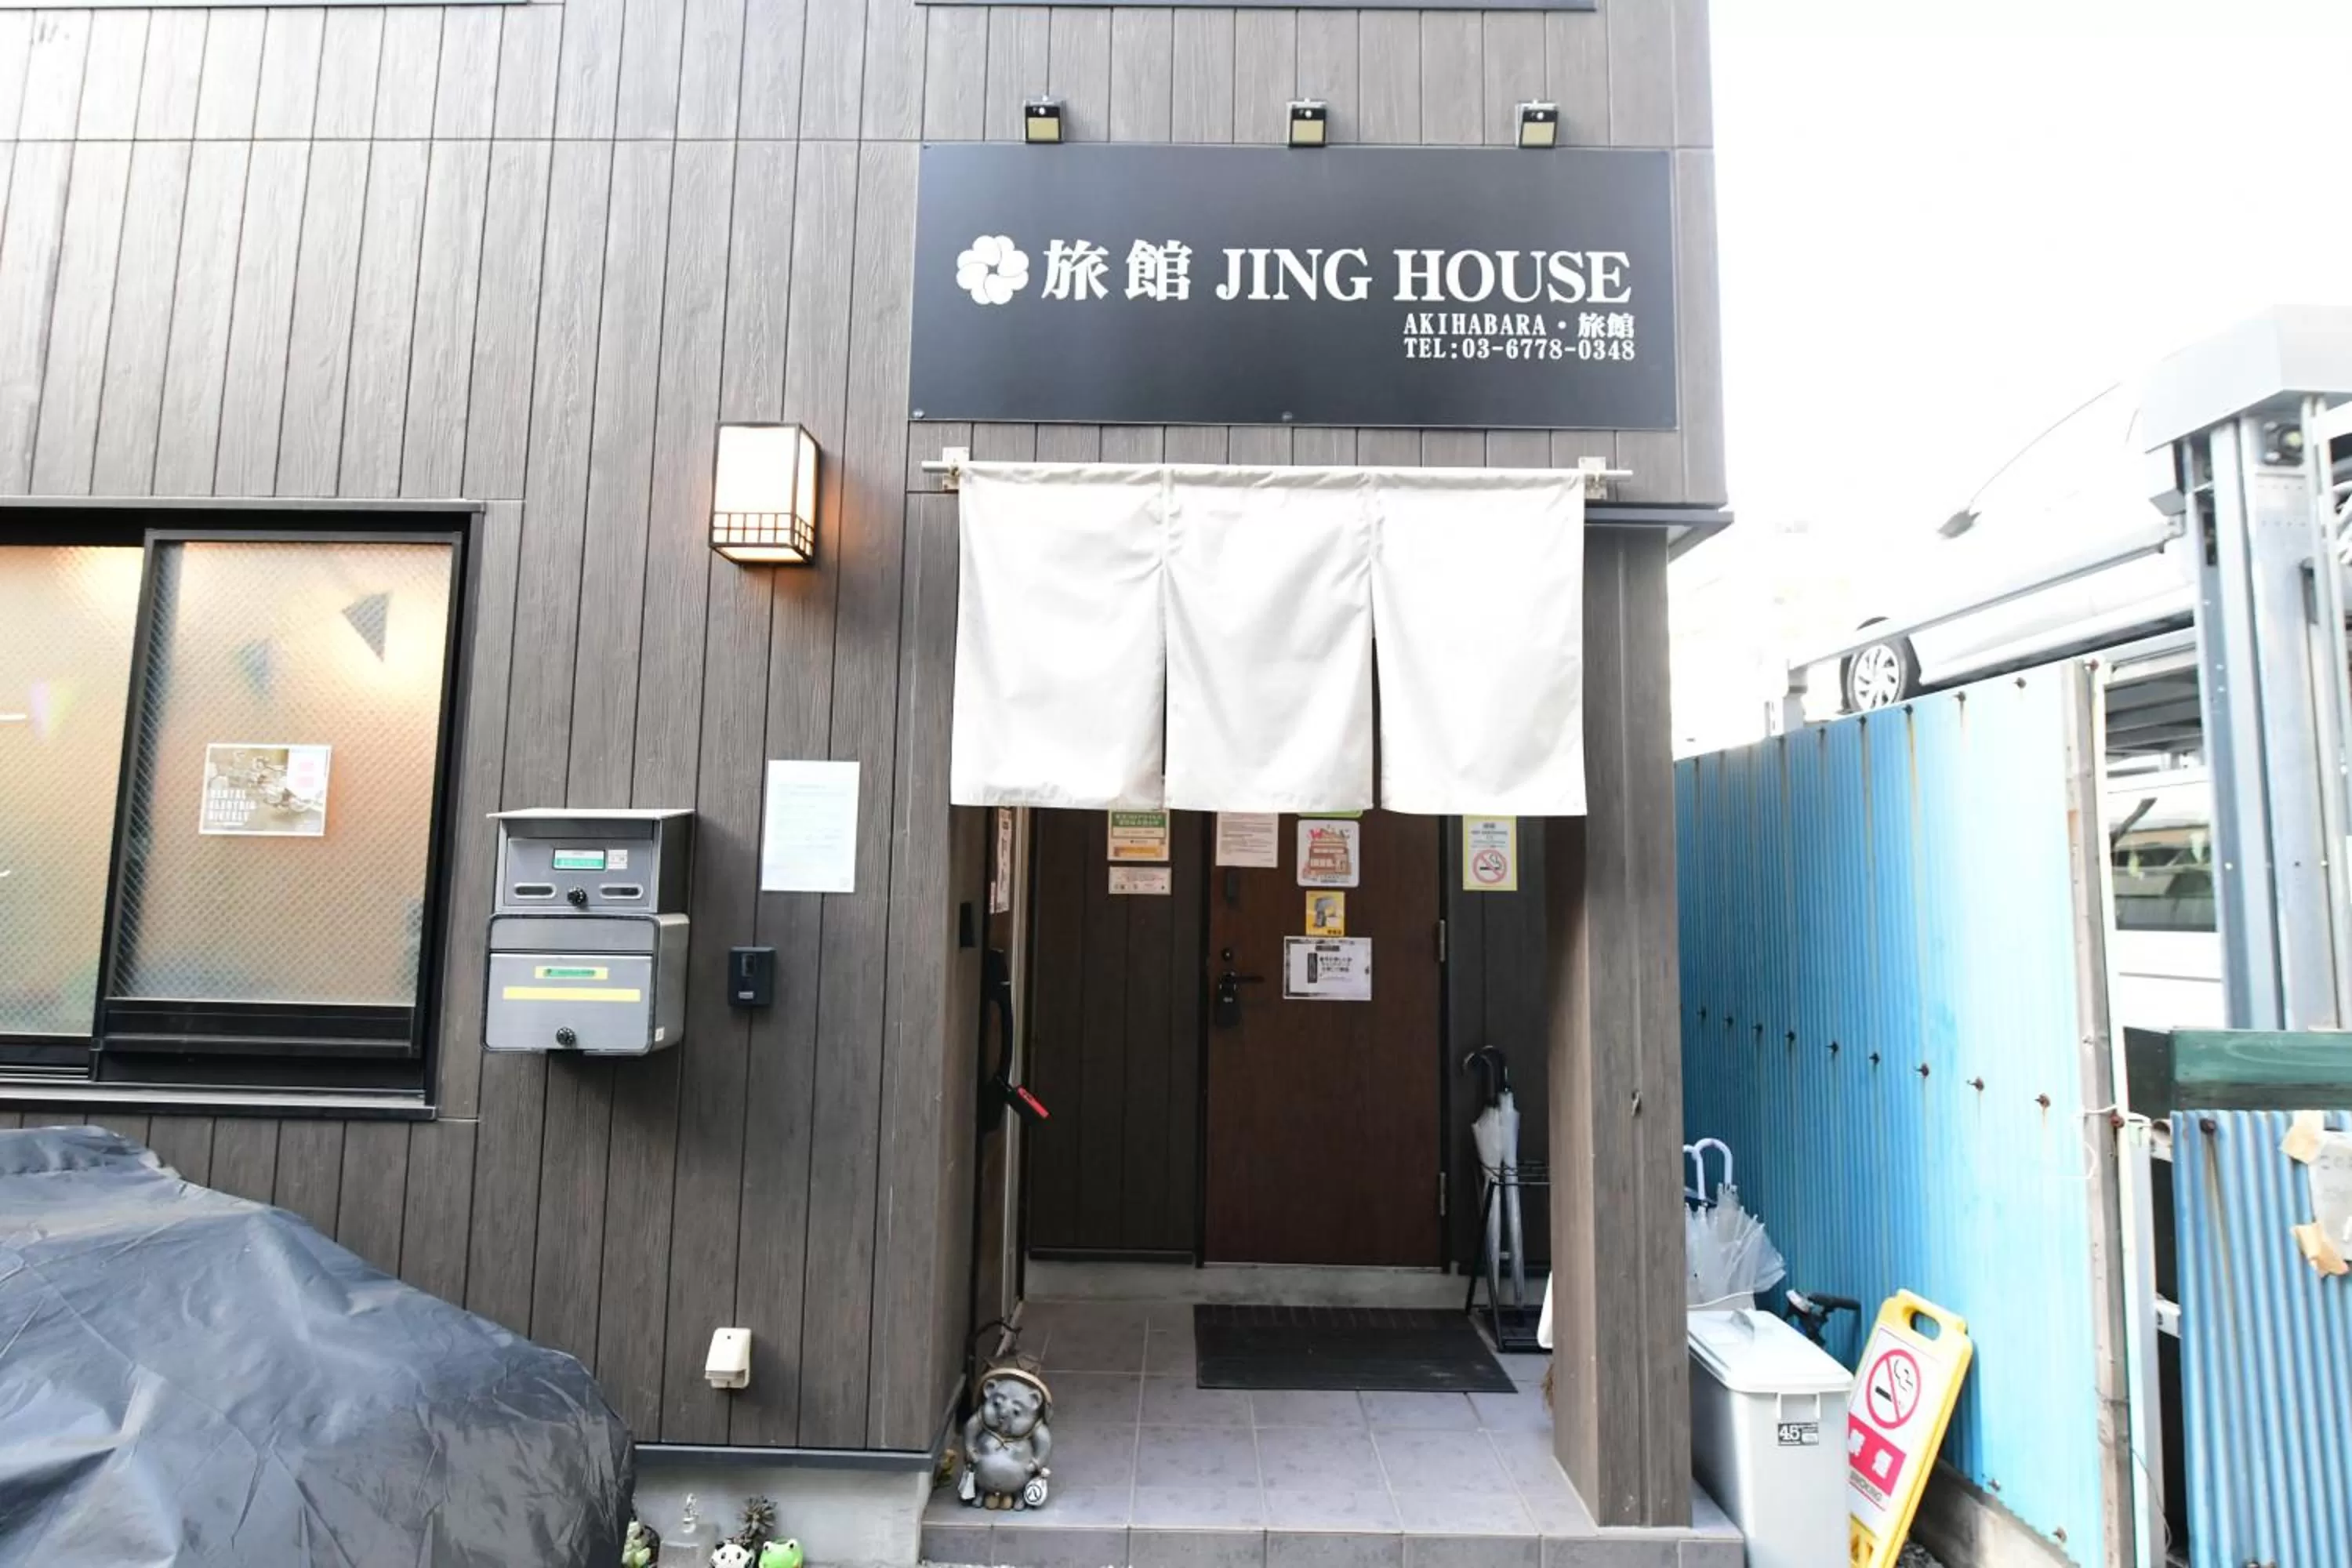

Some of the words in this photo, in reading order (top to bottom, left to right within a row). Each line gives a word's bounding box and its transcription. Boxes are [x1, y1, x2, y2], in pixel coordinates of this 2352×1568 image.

[1041, 239, 1192, 301] 旅館
[1215, 248, 1372, 302] JING
[1393, 249, 1632, 303] HOUSE
[1403, 313, 1547, 336] AKIHABARA
[1577, 312, 1635, 339] 旅館
